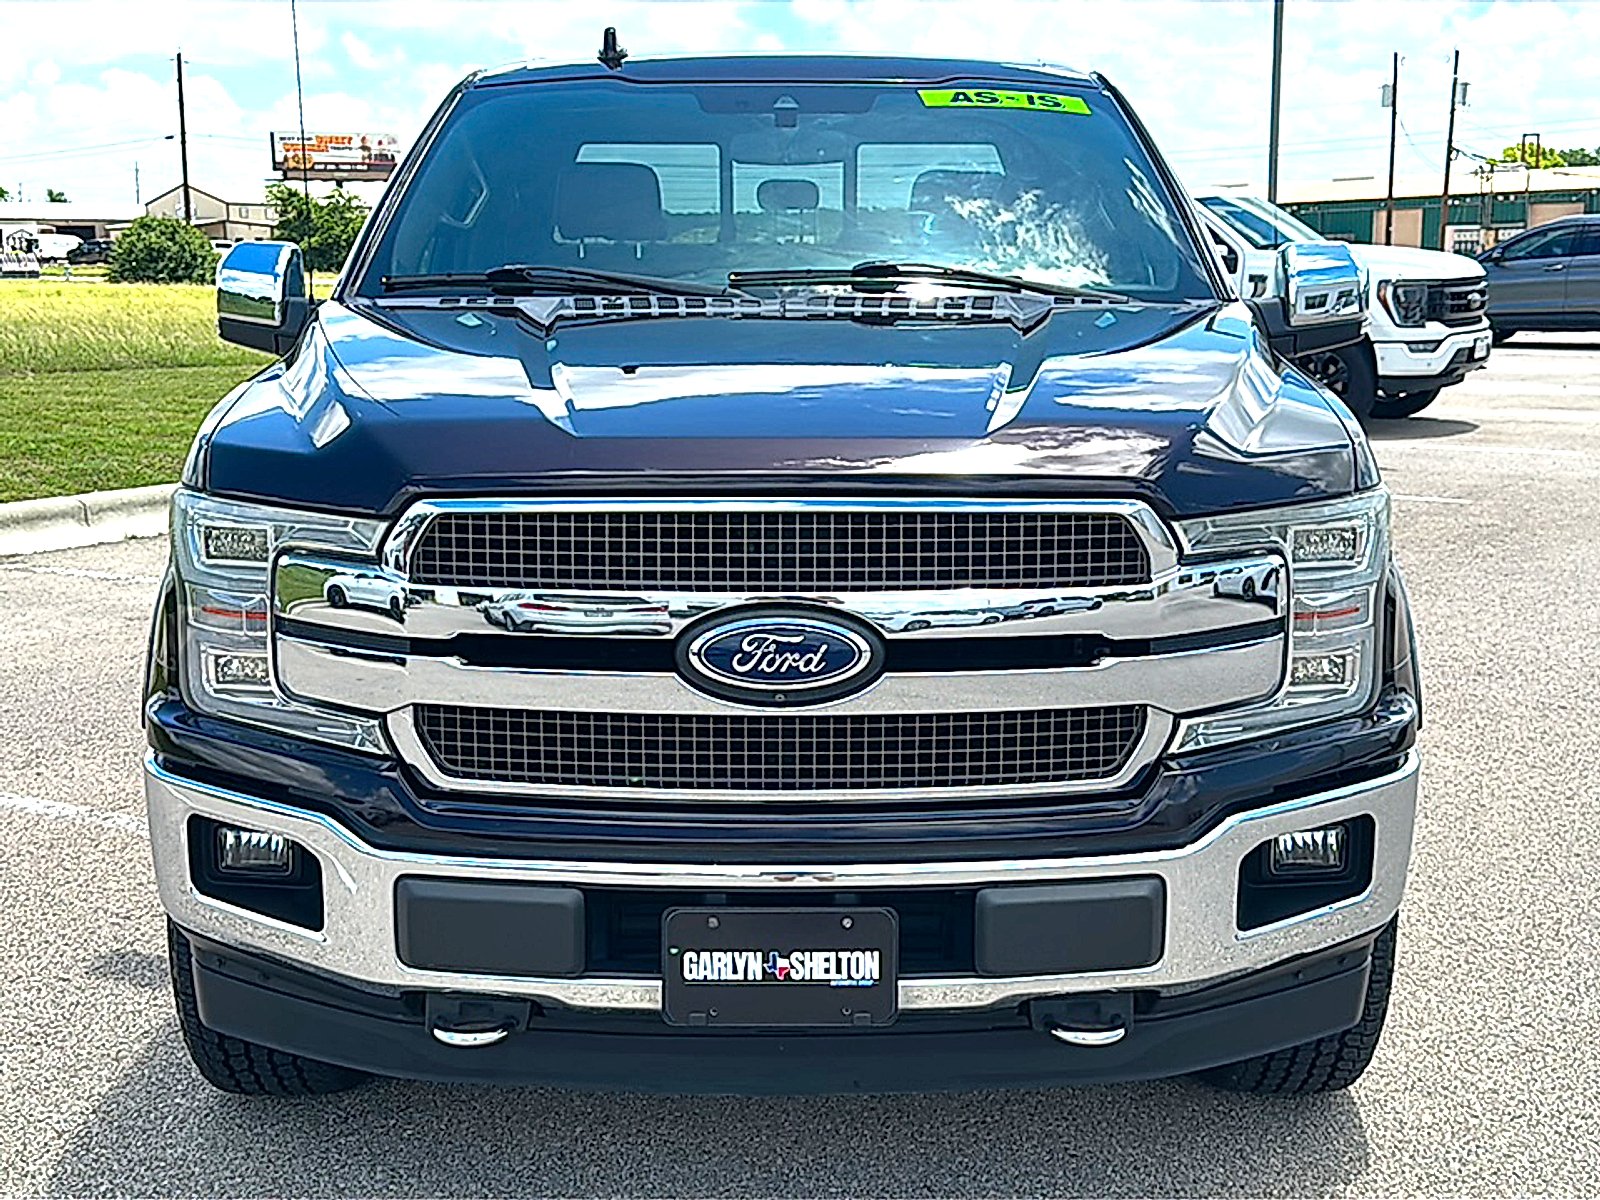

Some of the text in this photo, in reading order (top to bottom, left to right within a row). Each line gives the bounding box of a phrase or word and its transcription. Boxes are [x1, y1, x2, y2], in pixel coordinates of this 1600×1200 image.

[732, 633, 828, 673] Ford
[683, 951, 880, 980] GARLYN SHELTON
